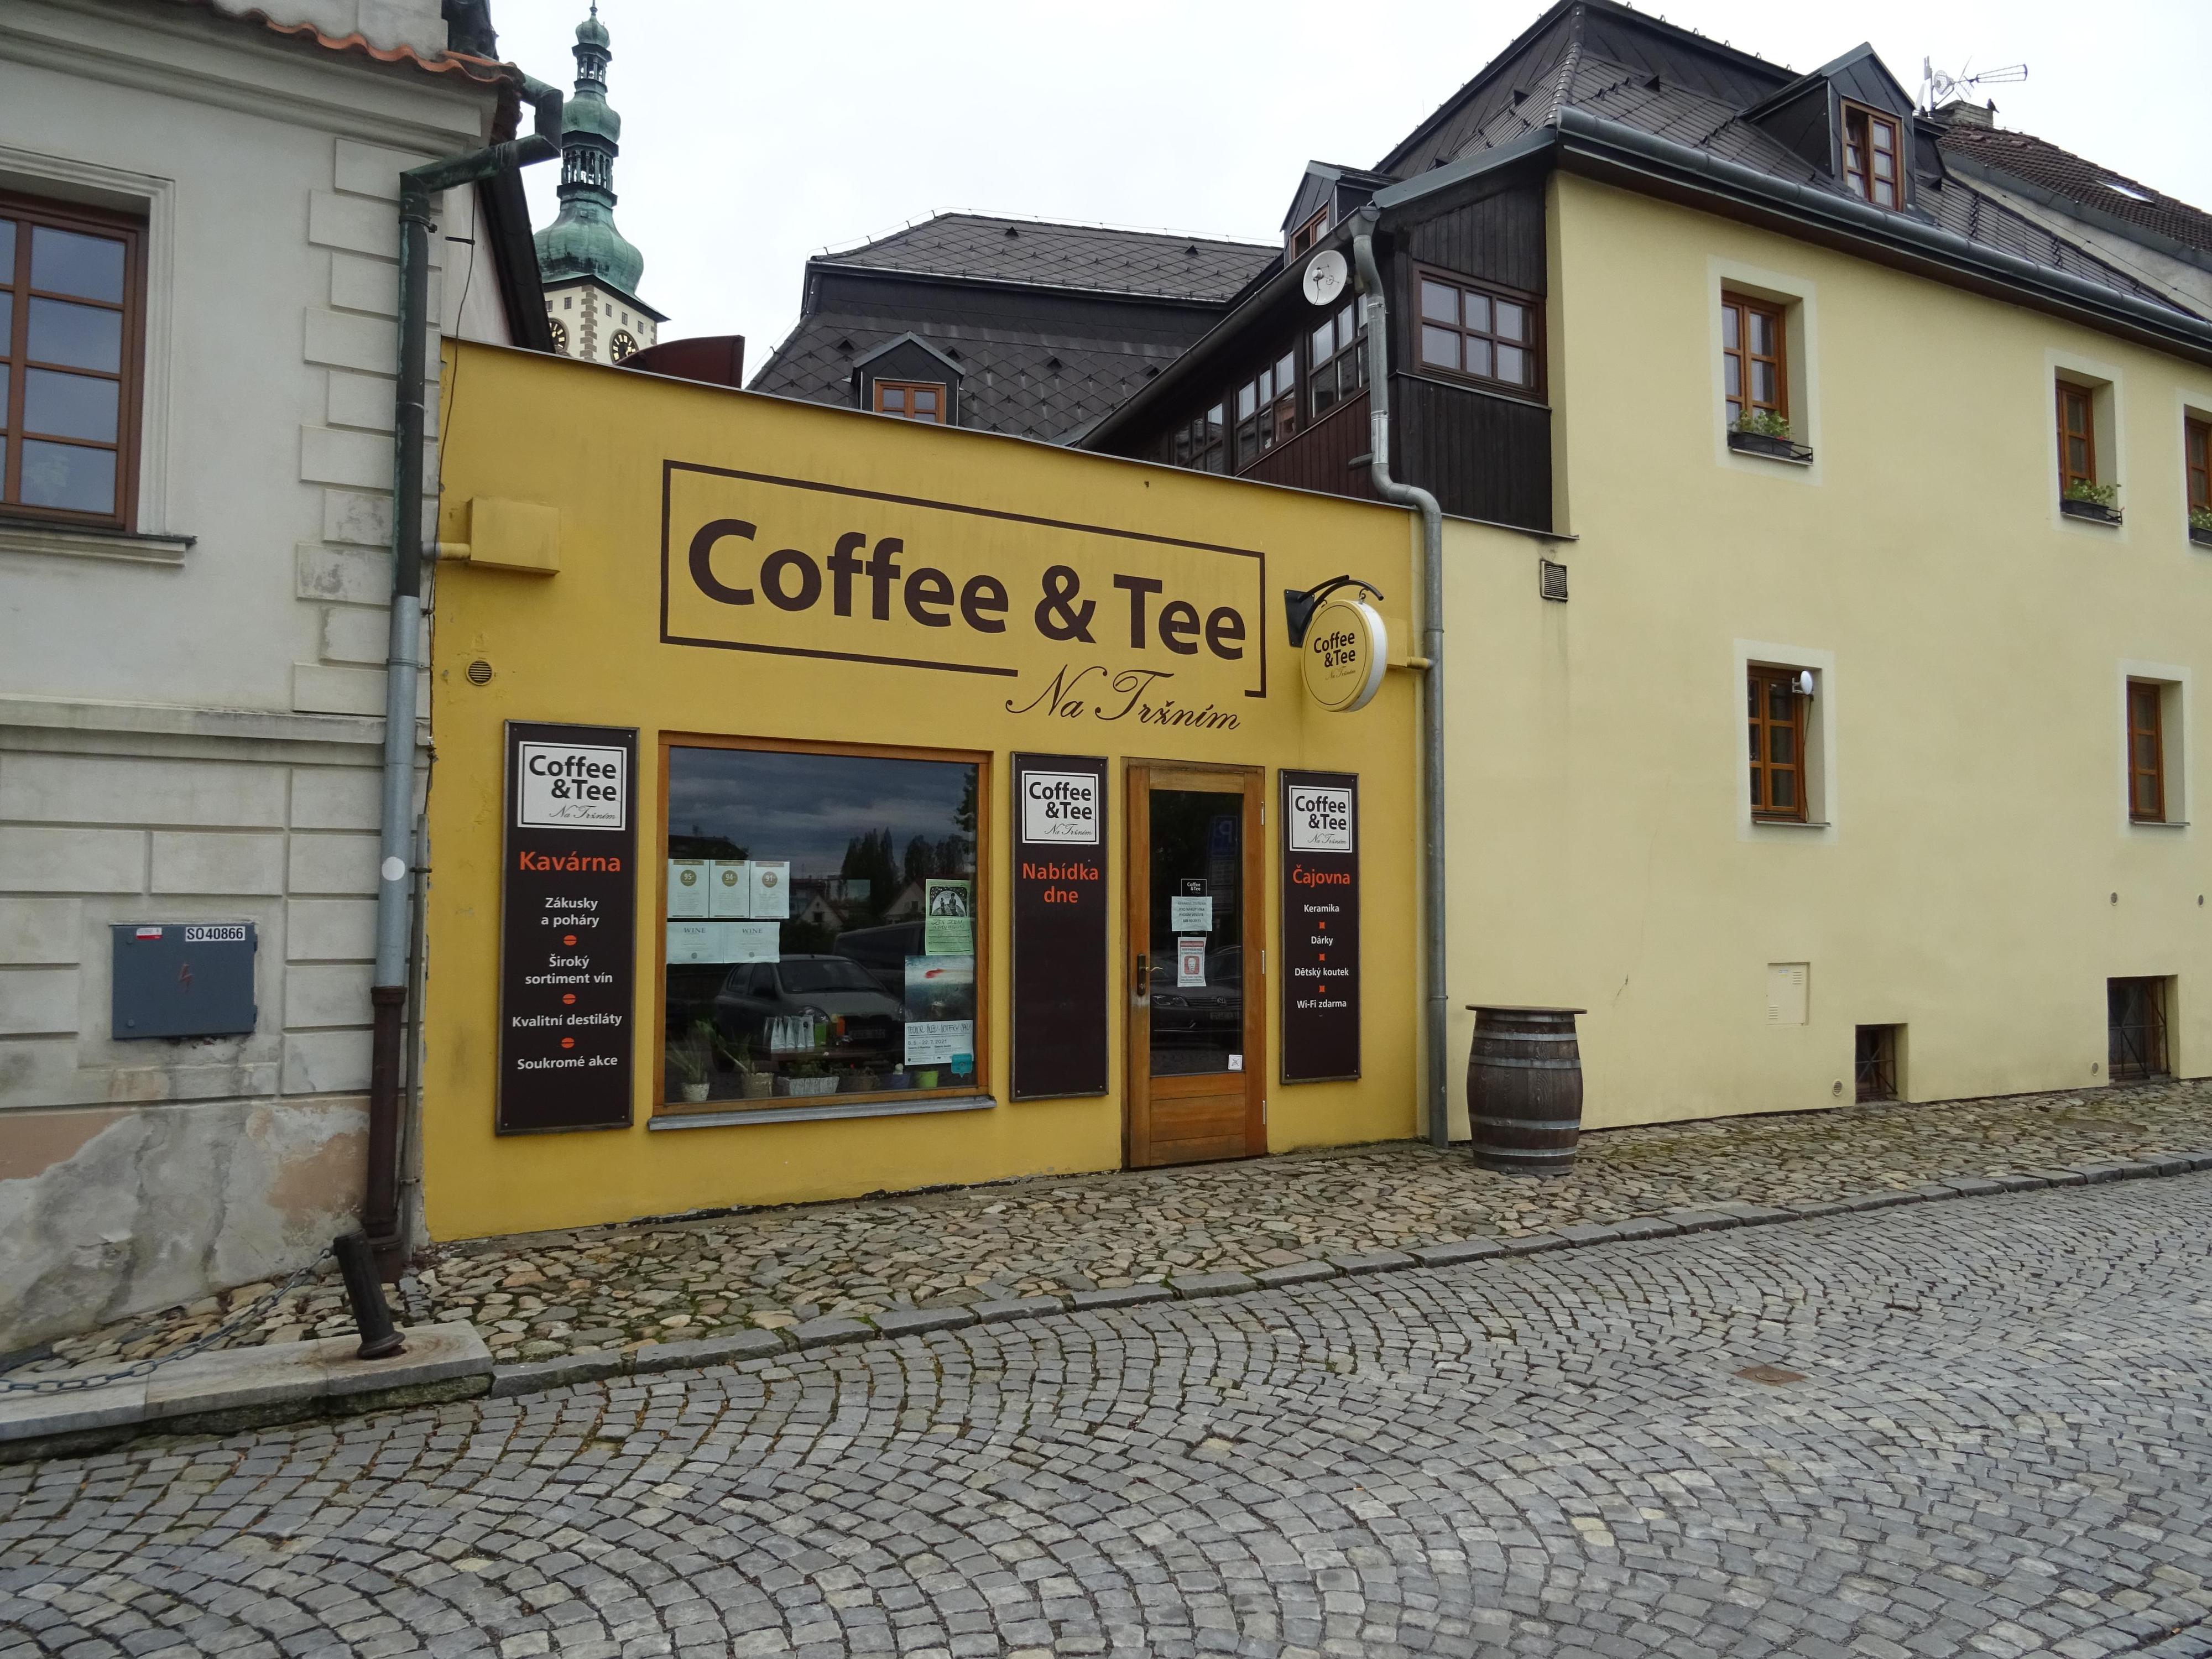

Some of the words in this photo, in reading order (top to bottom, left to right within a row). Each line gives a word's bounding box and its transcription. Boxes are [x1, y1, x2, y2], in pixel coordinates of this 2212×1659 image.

[688, 518, 1009, 634] Coffee
[1034, 565, 1097, 644] &
[1113, 573, 1245, 660] Tee
[1313, 631, 1355, 654] Coffee
[1324, 649, 1355, 668] &Tee
[1005, 664, 1107, 719] Na
[1094, 670, 1241, 731] Tržním
[529, 754, 617, 779] Coffee
[551, 779, 617, 801] &Tee
[1029, 781, 1092, 801] Coffee
[549, 805, 577, 818] Na
[573, 805, 615, 820] Tržním
[1045, 801, 1092, 820] &Tee
[1295, 795, 1346, 813] Coffee
[1044, 823, 1065, 834] Na
[1061, 823, 1092, 836] Tržním
[1308, 813, 1347, 830] &Tee
[1307, 833, 1324, 843] Na
[519, 851, 621, 872] Kavárna
[1022, 862, 1098, 880] Nabídka
[1292, 864, 1350, 888] Čajovna
[1044, 885, 1078, 903] dne
[545, 897, 598, 911] Zákusky
[1304, 904, 1339, 912] Keramika
[541, 917, 549, 925] a
[553, 914, 599, 928] poháry
[1311, 935, 1333, 946] Dárky
[549, 953, 590, 969] Široký
[525, 973, 590, 984] sortiment
[593, 972, 613, 983] vín
[1295, 967, 1321, 978] Dětský
[1323, 967, 1349, 976] koutek
[1297, 999, 1316, 1009] Wi-Fi
[1318, 999, 1347, 1008] zdarma
[512, 1014, 563, 1027] Kvalitní
[566, 1013, 622, 1026] destiláty
[517, 1055, 585, 1070] Soukromé
[588, 1055, 618, 1066] akce
